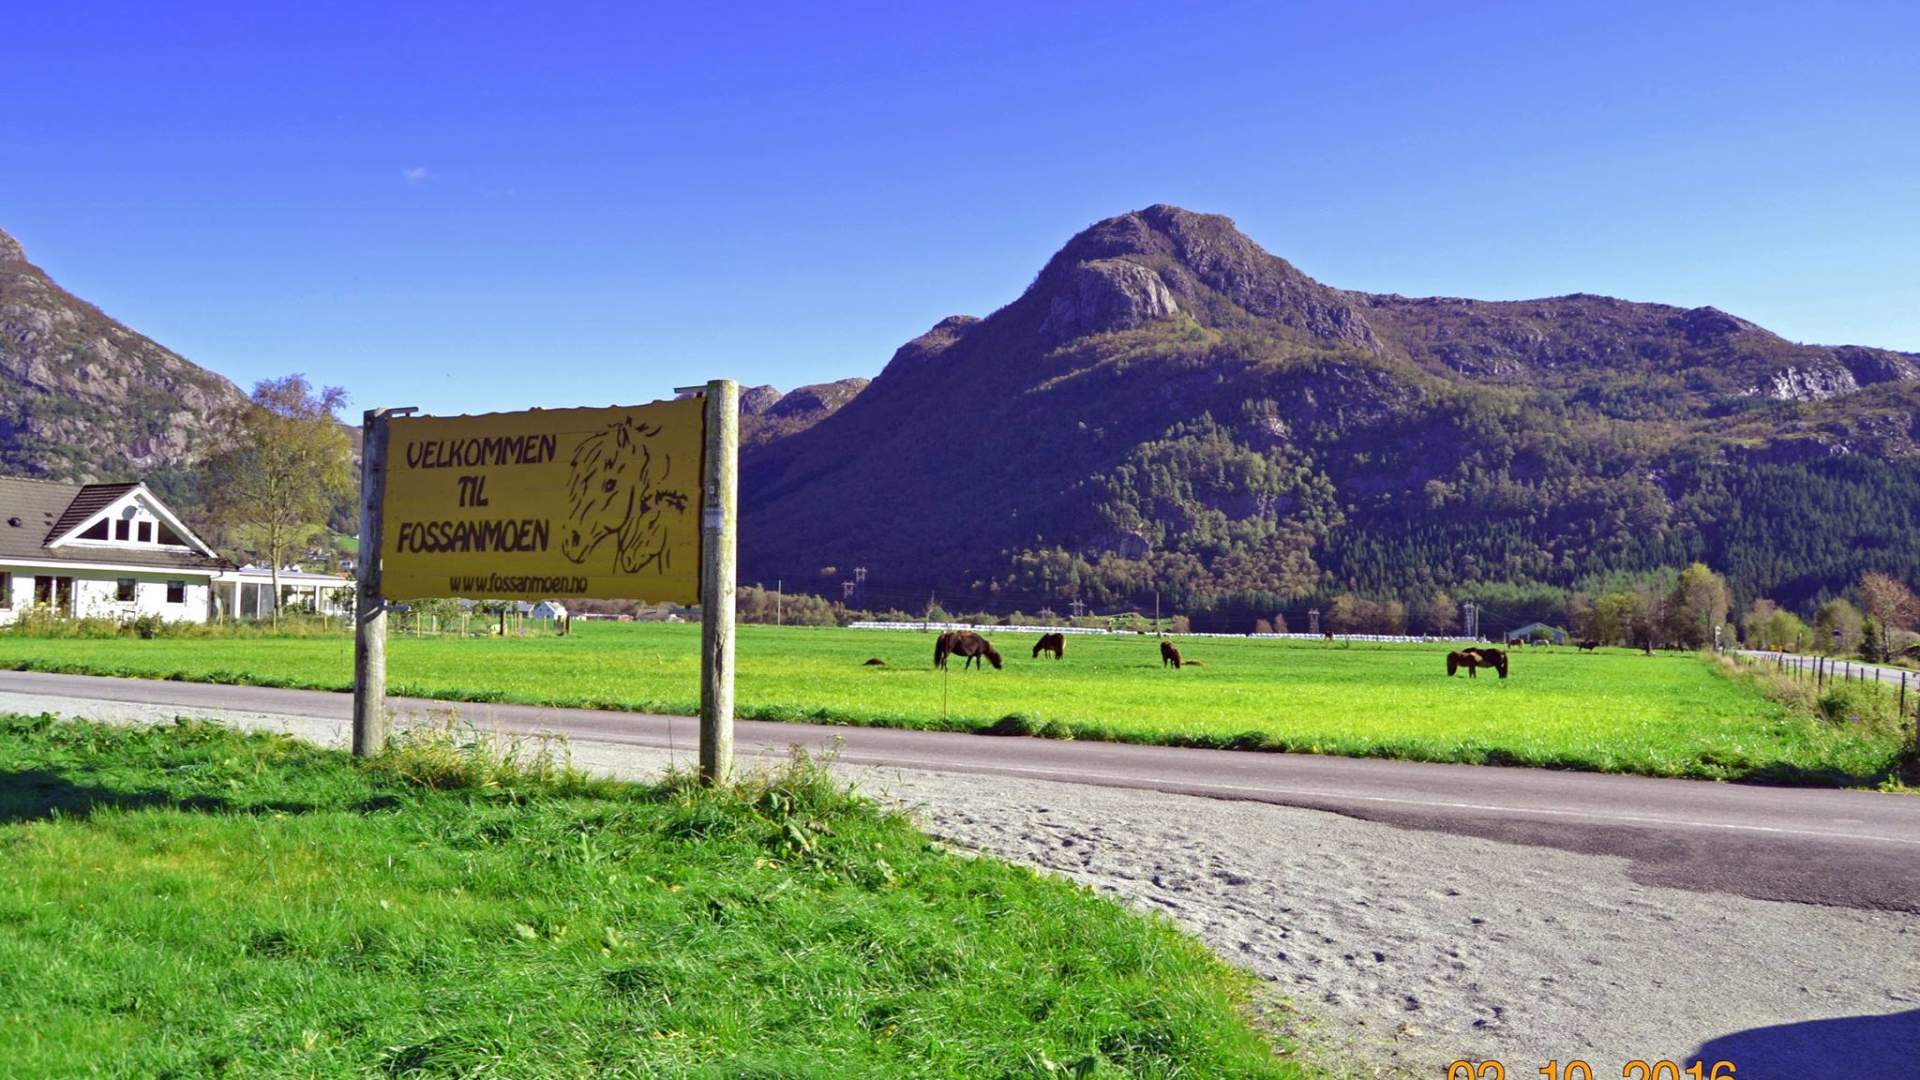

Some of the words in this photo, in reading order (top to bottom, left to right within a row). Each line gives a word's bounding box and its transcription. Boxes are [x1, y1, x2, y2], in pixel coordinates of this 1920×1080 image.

[406, 433, 557, 468] VELKOMMEN
[457, 475, 489, 507] TIL
[397, 519, 549, 553] FOSSANMOEN
[449, 572, 588, 593] www.fossanmoen.no
